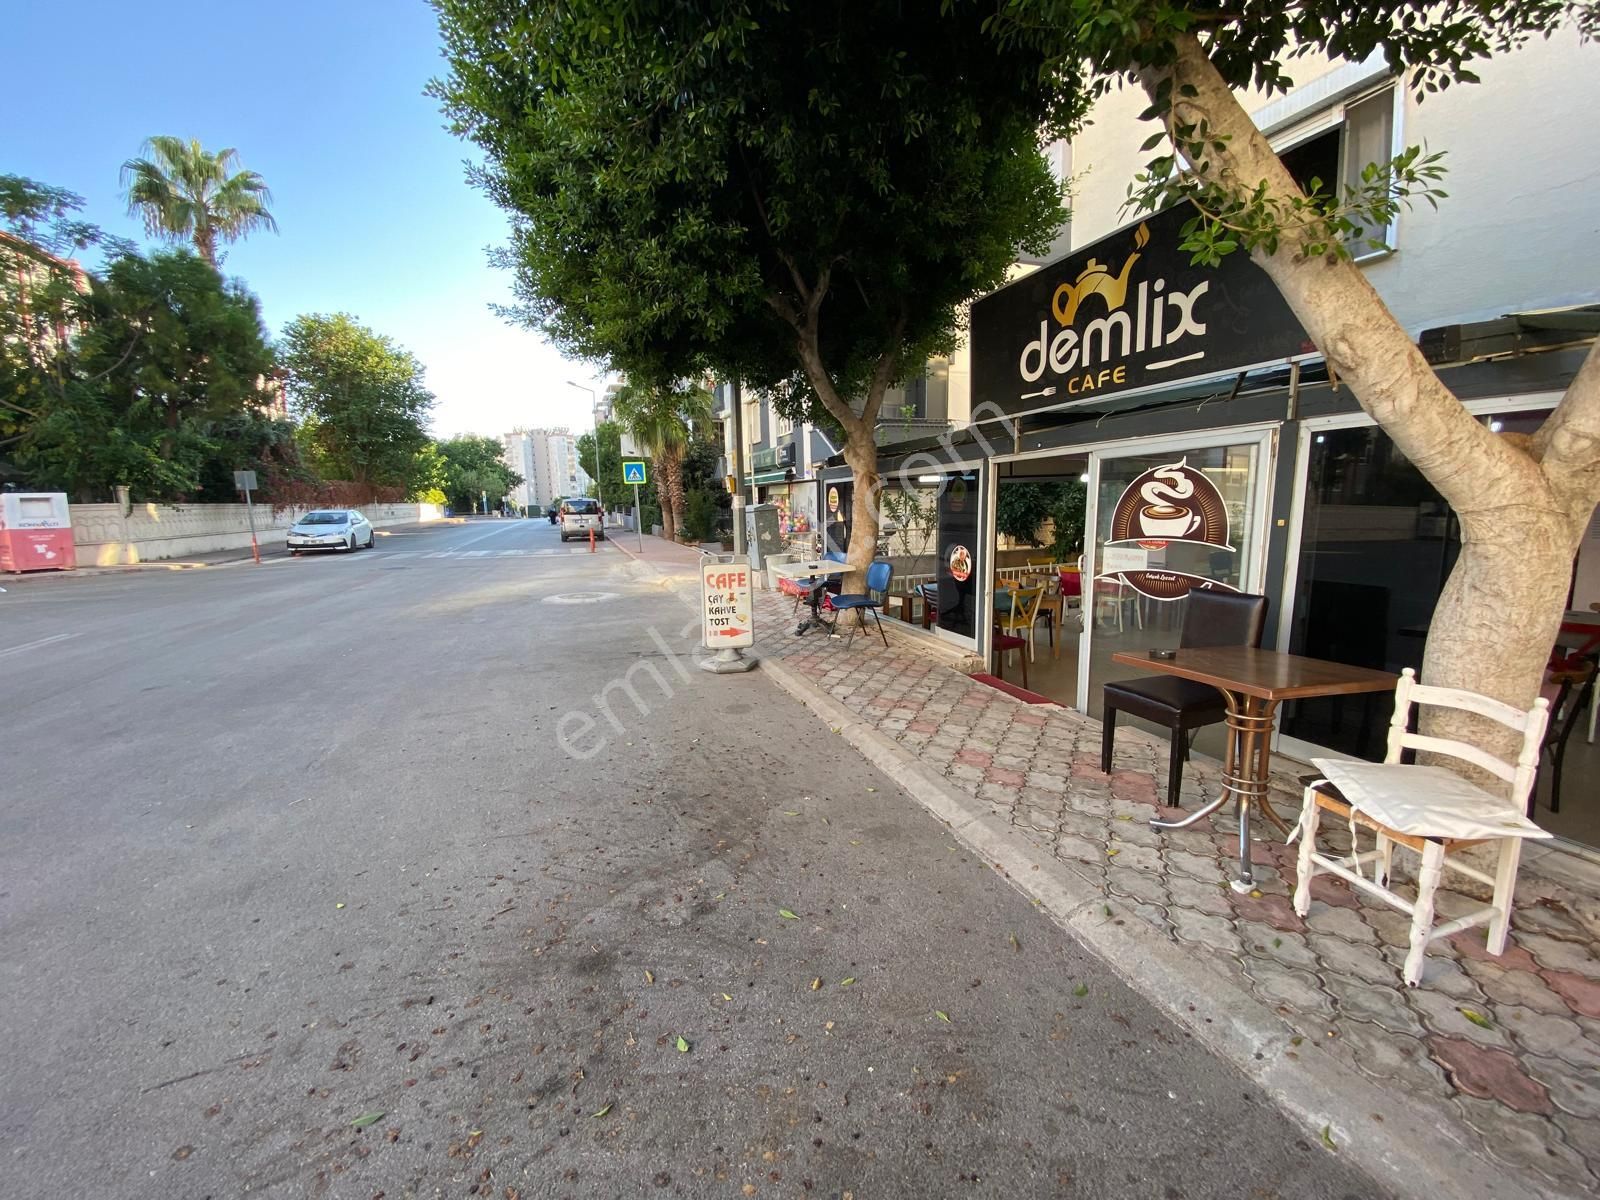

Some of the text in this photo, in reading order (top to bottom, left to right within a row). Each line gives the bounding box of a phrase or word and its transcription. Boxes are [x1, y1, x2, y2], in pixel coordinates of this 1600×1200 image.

[1019, 278, 1209, 382] demlix
[1068, 365, 1126, 394] CAFE
[706, 572, 747, 590] CAFE
[708, 594, 724, 605] ÇAY
[708, 606, 737, 615] KAHVE
[709, 617, 730, 626] TOST
